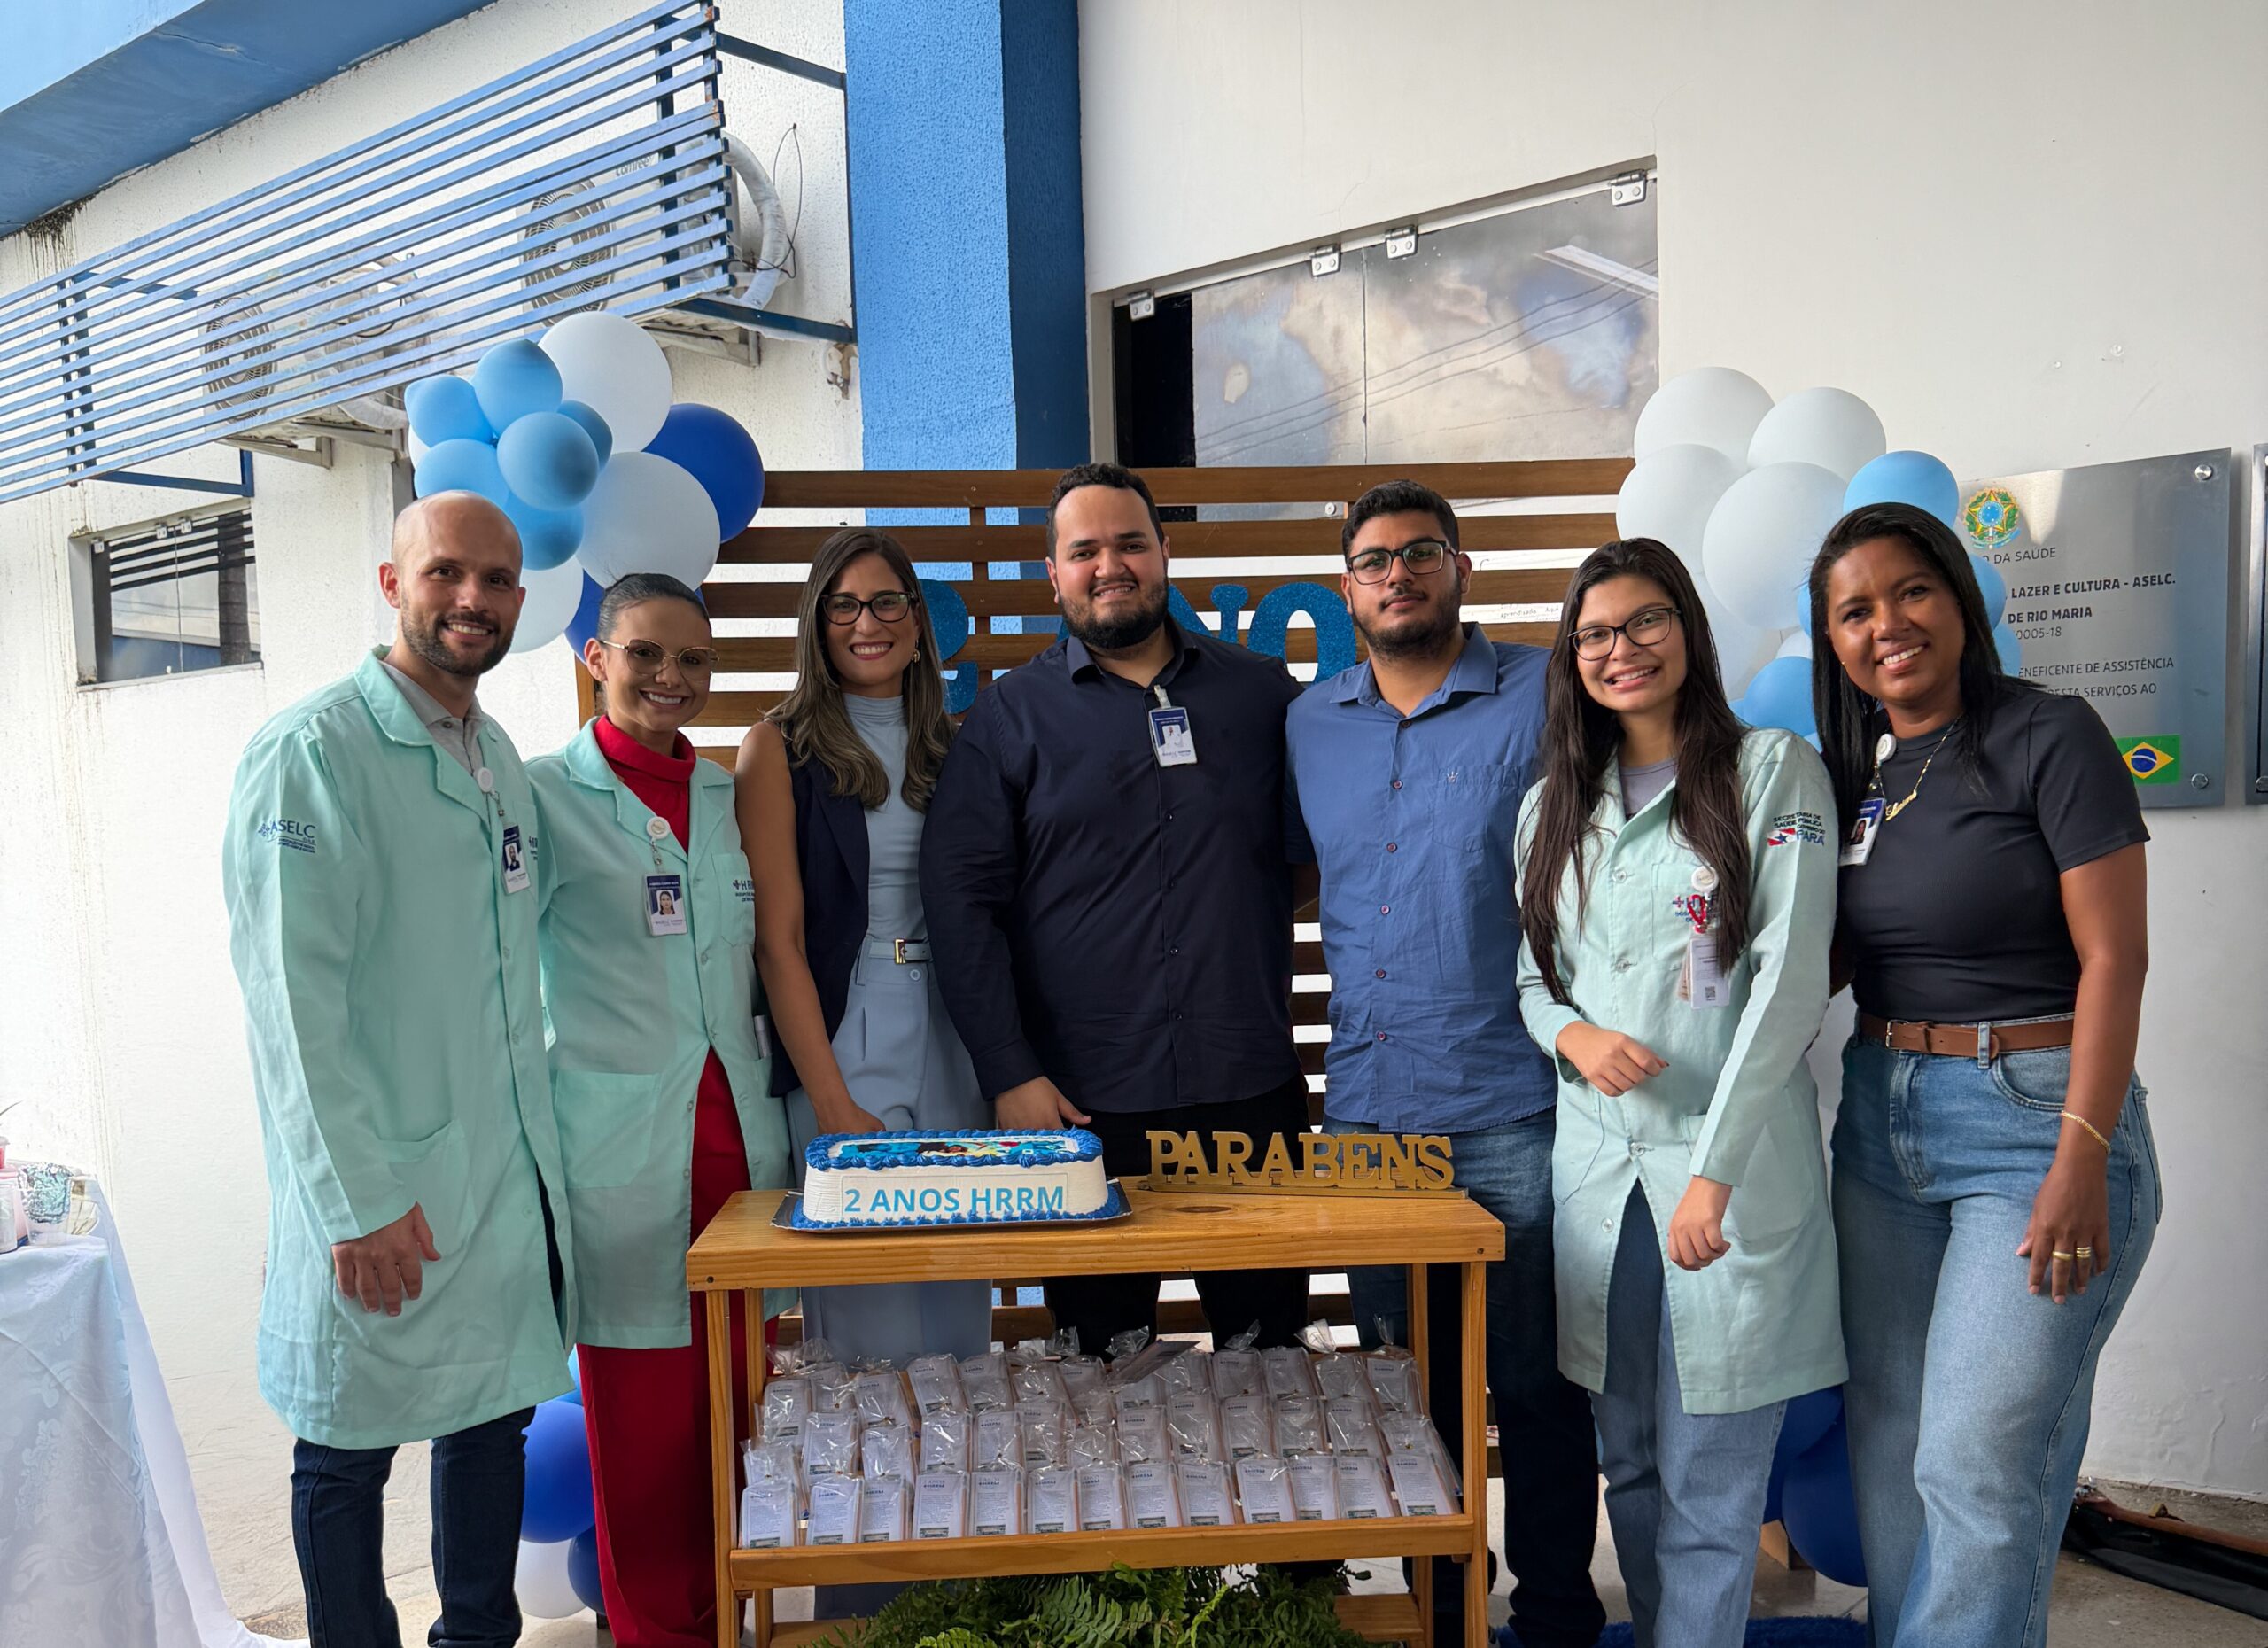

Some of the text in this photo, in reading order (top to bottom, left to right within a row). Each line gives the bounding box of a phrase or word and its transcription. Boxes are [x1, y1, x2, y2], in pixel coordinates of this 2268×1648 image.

[1993, 553, 2011, 564] DA
[2015, 547, 2057, 562] SAÚDE
[2011, 585, 2050, 599] LAZER
[2054, 584, 2061, 595] E
[2064, 579, 2121, 594] CULTURA
[2132, 573, 2176, 588] ASELC.
[2008, 606, 2093, 624] DE RIO MARIA
[2015, 626, 2062, 640] 0005-18
[2018, 657, 2174, 678] ENEFICENTE DE ASSISTÊNCIA
[2084, 683, 2138, 698] SERVIÇOS
[2140, 682, 2157, 694] AO
[269, 819, 316, 839] ASELC
[844, 1185, 1064, 1212] 2 ANOS HRRM
